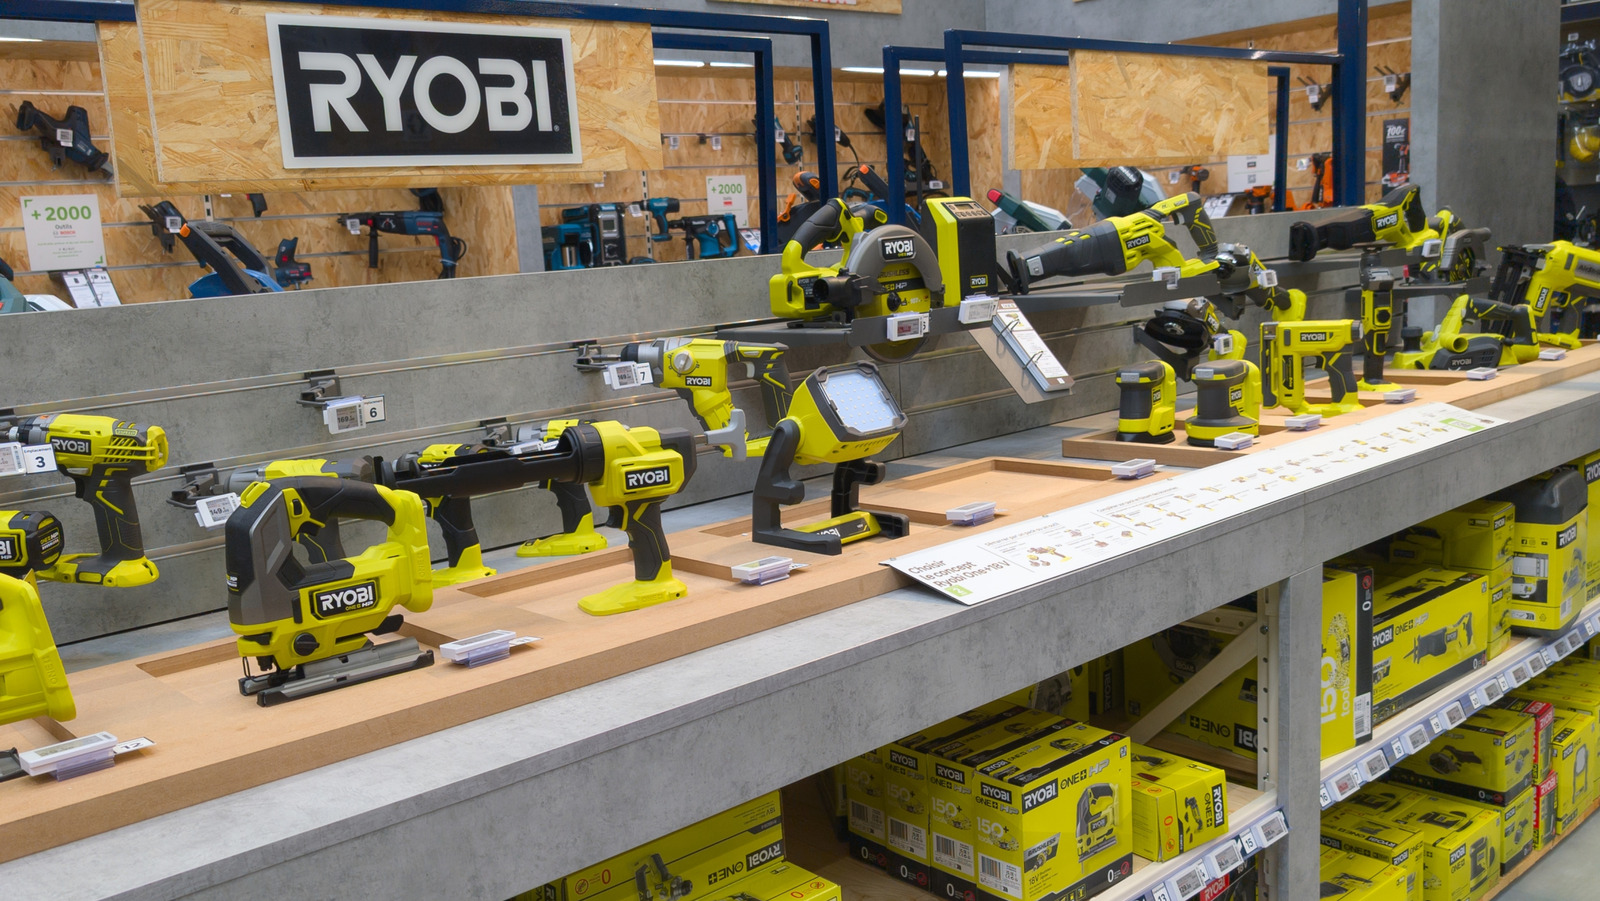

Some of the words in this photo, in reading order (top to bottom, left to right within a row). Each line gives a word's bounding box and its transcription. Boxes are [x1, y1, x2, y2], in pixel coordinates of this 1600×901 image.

[298, 51, 553, 134] RYOBI
[885, 239, 914, 254] RYOBI
[1127, 236, 1149, 248] RYOBI
[971, 277, 986, 285] RYOBI
[1301, 333, 1326, 341] RYOBI
[1452, 358, 1472, 366] RYOBI
[640, 372, 646, 381] 7
[686, 377, 711, 386] RYOBI
[370, 407, 378, 418] 6
[51, 438, 89, 453] RYOBI
[35, 456, 45, 468] 3
[627, 469, 668, 487] RYOBI
[1558, 525, 1578, 546] RYOBI
[908, 560, 946, 574] Choisir
[934, 561, 977, 578] concept
[933, 573, 966, 587] Ryobi
[320, 586, 374, 611] RYOBI
[1372, 629, 1393, 648] RYOBI
[1341, 678, 1350, 717] tools
[891, 751, 917, 768] RYOBI
[937, 765, 963, 782] RYOBI
[1024, 782, 1057, 810] RYOBI
[1060, 768, 1087, 790] ONE+
[1088, 759, 1109, 778] HP
[1541, 776, 1557, 795] RYOBI
[982, 784, 1011, 802] RYOBI
[1214, 786, 1224, 826] RYOBI
[976, 816, 1009, 838] 150+
[1245, 838, 1254, 849] 15
[748, 843, 782, 868] RYOBI
[1392, 850, 1409, 866] RYOBI
[1450, 844, 1466, 866] RYOBI
[601, 869, 611, 885] 0
[900, 864, 908, 878] 0
[1107, 869, 1114, 883] 0
[947, 883, 955, 897] 0
[1204, 876, 1226, 901] RYOBI
